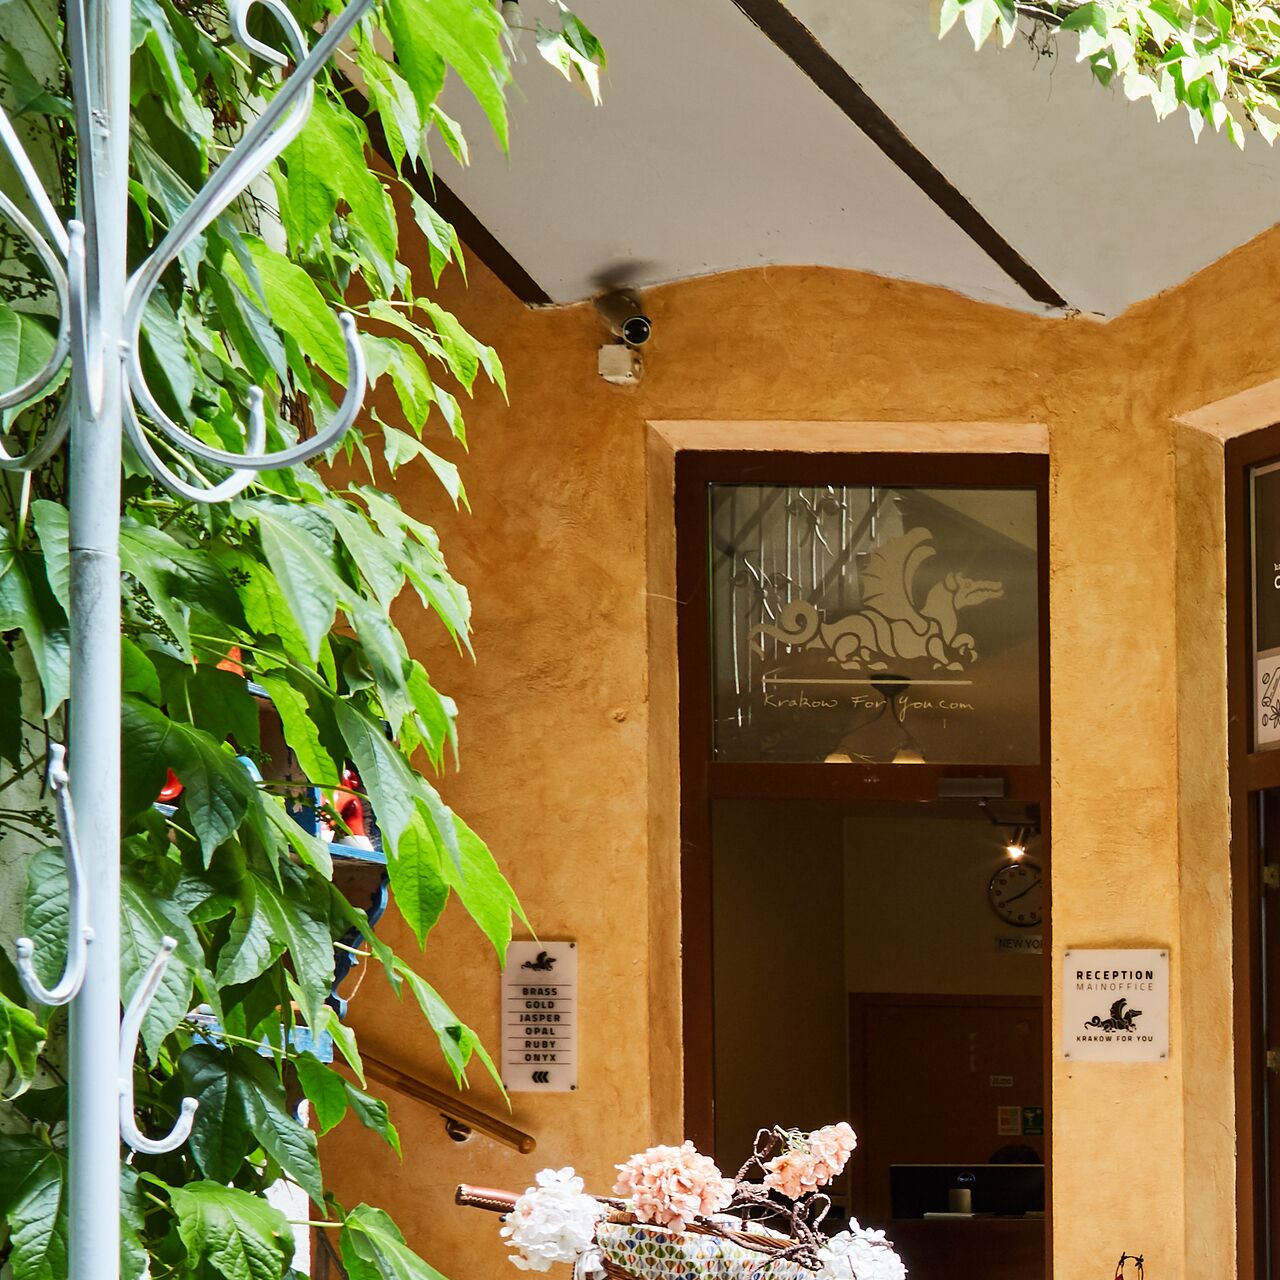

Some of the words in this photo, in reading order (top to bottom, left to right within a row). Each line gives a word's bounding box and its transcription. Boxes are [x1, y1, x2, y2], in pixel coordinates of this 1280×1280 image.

[762, 690, 839, 709] Krakow
[851, 695, 887, 709] For
[899, 695, 974, 722] You.com
[999, 938, 1023, 949] NEW
[1025, 938, 1042, 950] YO
[1076, 970, 1153, 980] RECEPTION
[1076, 982, 1153, 991] MAINOFFICE
[522, 987, 557, 996] BRASS
[525, 1001, 555, 1009] GOLD
[519, 1014, 560, 1022] JASPER
[525, 1027, 555, 1035] OPAL
[525, 1040, 556, 1048] RUBY
